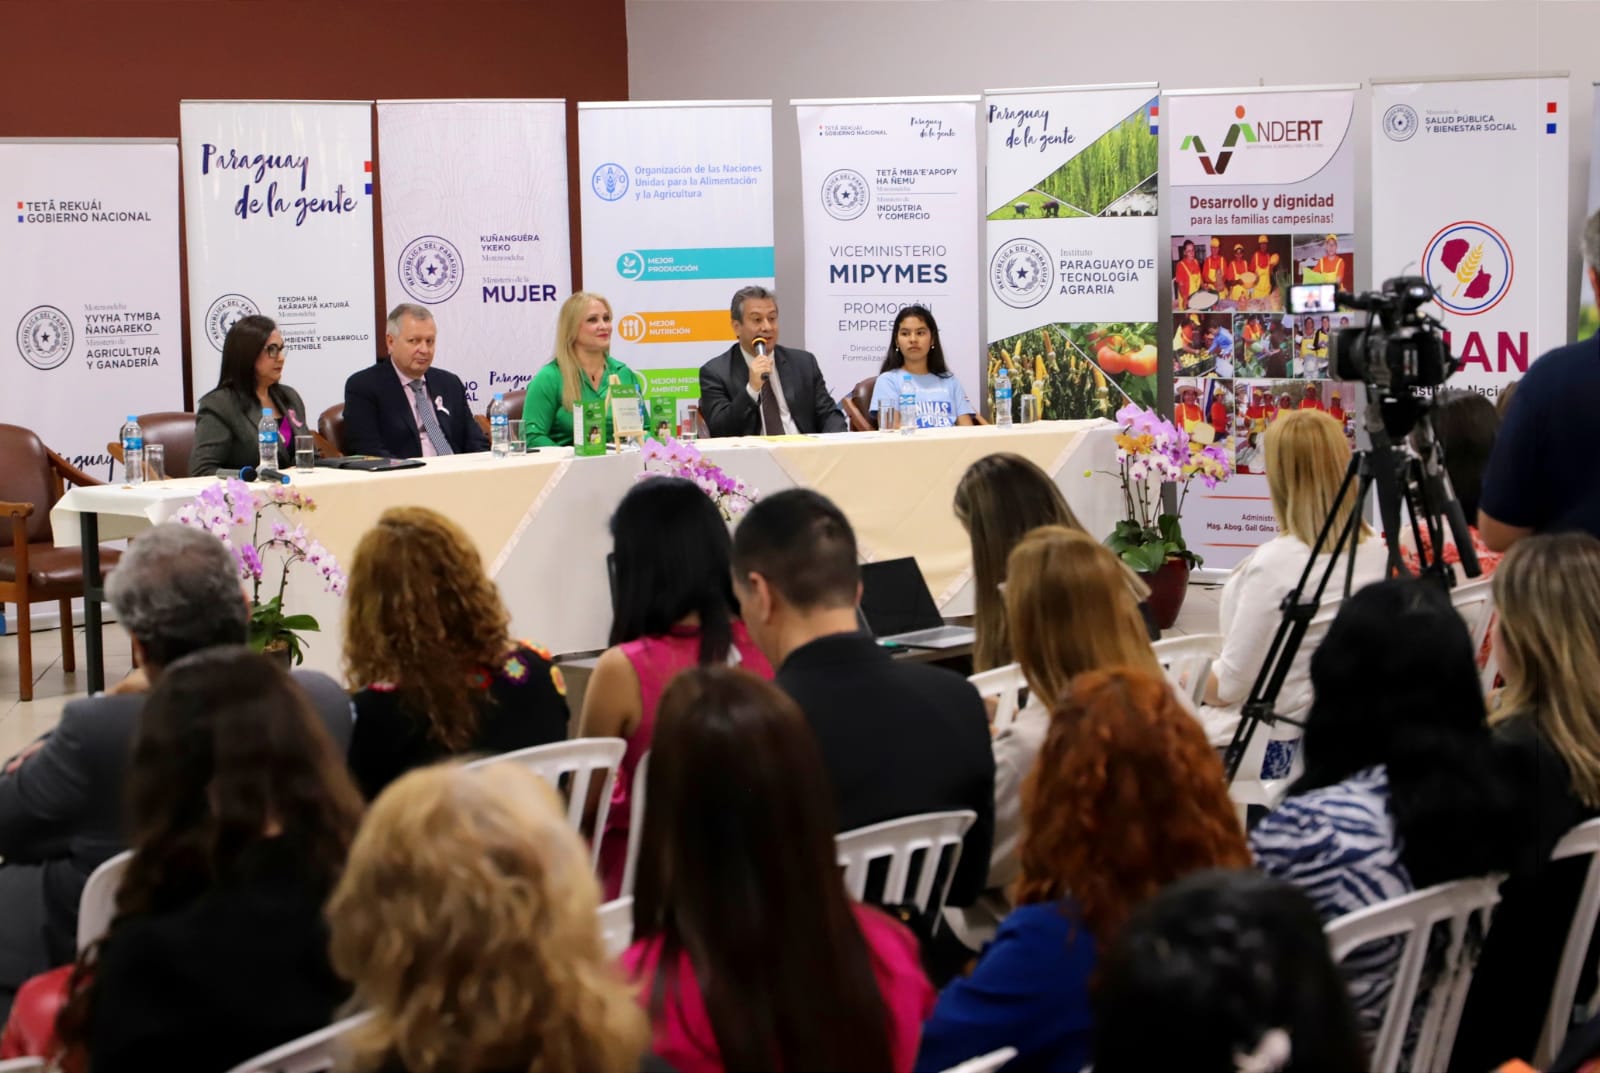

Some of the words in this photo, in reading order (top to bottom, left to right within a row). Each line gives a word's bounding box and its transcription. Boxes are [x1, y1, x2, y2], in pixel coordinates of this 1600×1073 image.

[989, 105, 1049, 131] Paraguay
[1456, 113, 1495, 122] PÚBLICA
[1433, 124, 1482, 133] BIENESTAR
[1484, 123, 1517, 131] SOCIAL
[1006, 128, 1021, 149] de
[1024, 126, 1037, 147] la
[1039, 127, 1077, 152] gente
[201, 143, 309, 191] Paraguay
[694, 164, 705, 173] de
[708, 164, 720, 173] las
[723, 163, 762, 173] Naciones
[635, 177, 664, 187] Unidas
[891, 176, 916, 184] ÑEMU
[653, 189, 702, 200] Agricultura
[234, 184, 264, 219] de
[267, 181, 291, 217] la
[294, 184, 357, 227] gente
[877, 204, 922, 212] INDUSTRIA
[1190, 194, 1258, 209] Desarrollo
[1262, 197, 1270, 211] y
[1273, 193, 1334, 210] dignidad
[27, 213, 88, 223] GOBIERNO
[92, 212, 151, 221] NACIONAL
[885, 212, 930, 220] COMERCIO
[1190, 217, 1212, 227] para
[1215, 215, 1228, 224] las
[1231, 213, 1270, 225] familias
[1272, 212, 1334, 225] campesinas!
[829, 245, 947, 257] VICEMINISTERIO
[1060, 260, 1135, 269] PARAGUAYO
[1137, 259, 1154, 269] DE
[830, 264, 948, 283] MIPYMES
[1060, 270, 1139, 282] TECNOLOGÍA
[482, 284, 557, 303] MUJER
[1060, 285, 1115, 295] AGRARIA
[85, 313, 121, 323] YVYHA
[124, 312, 161, 321] TYMBA
[85, 323, 153, 335] ÑANGAREKO
[322, 334, 369, 342] DESARROLLO
[86, 346, 161, 358] AGRICULTURA
[87, 361, 93, 370] Y
[96, 357, 159, 369] GANADERÍA
[490, 371, 532, 388] Paragua
